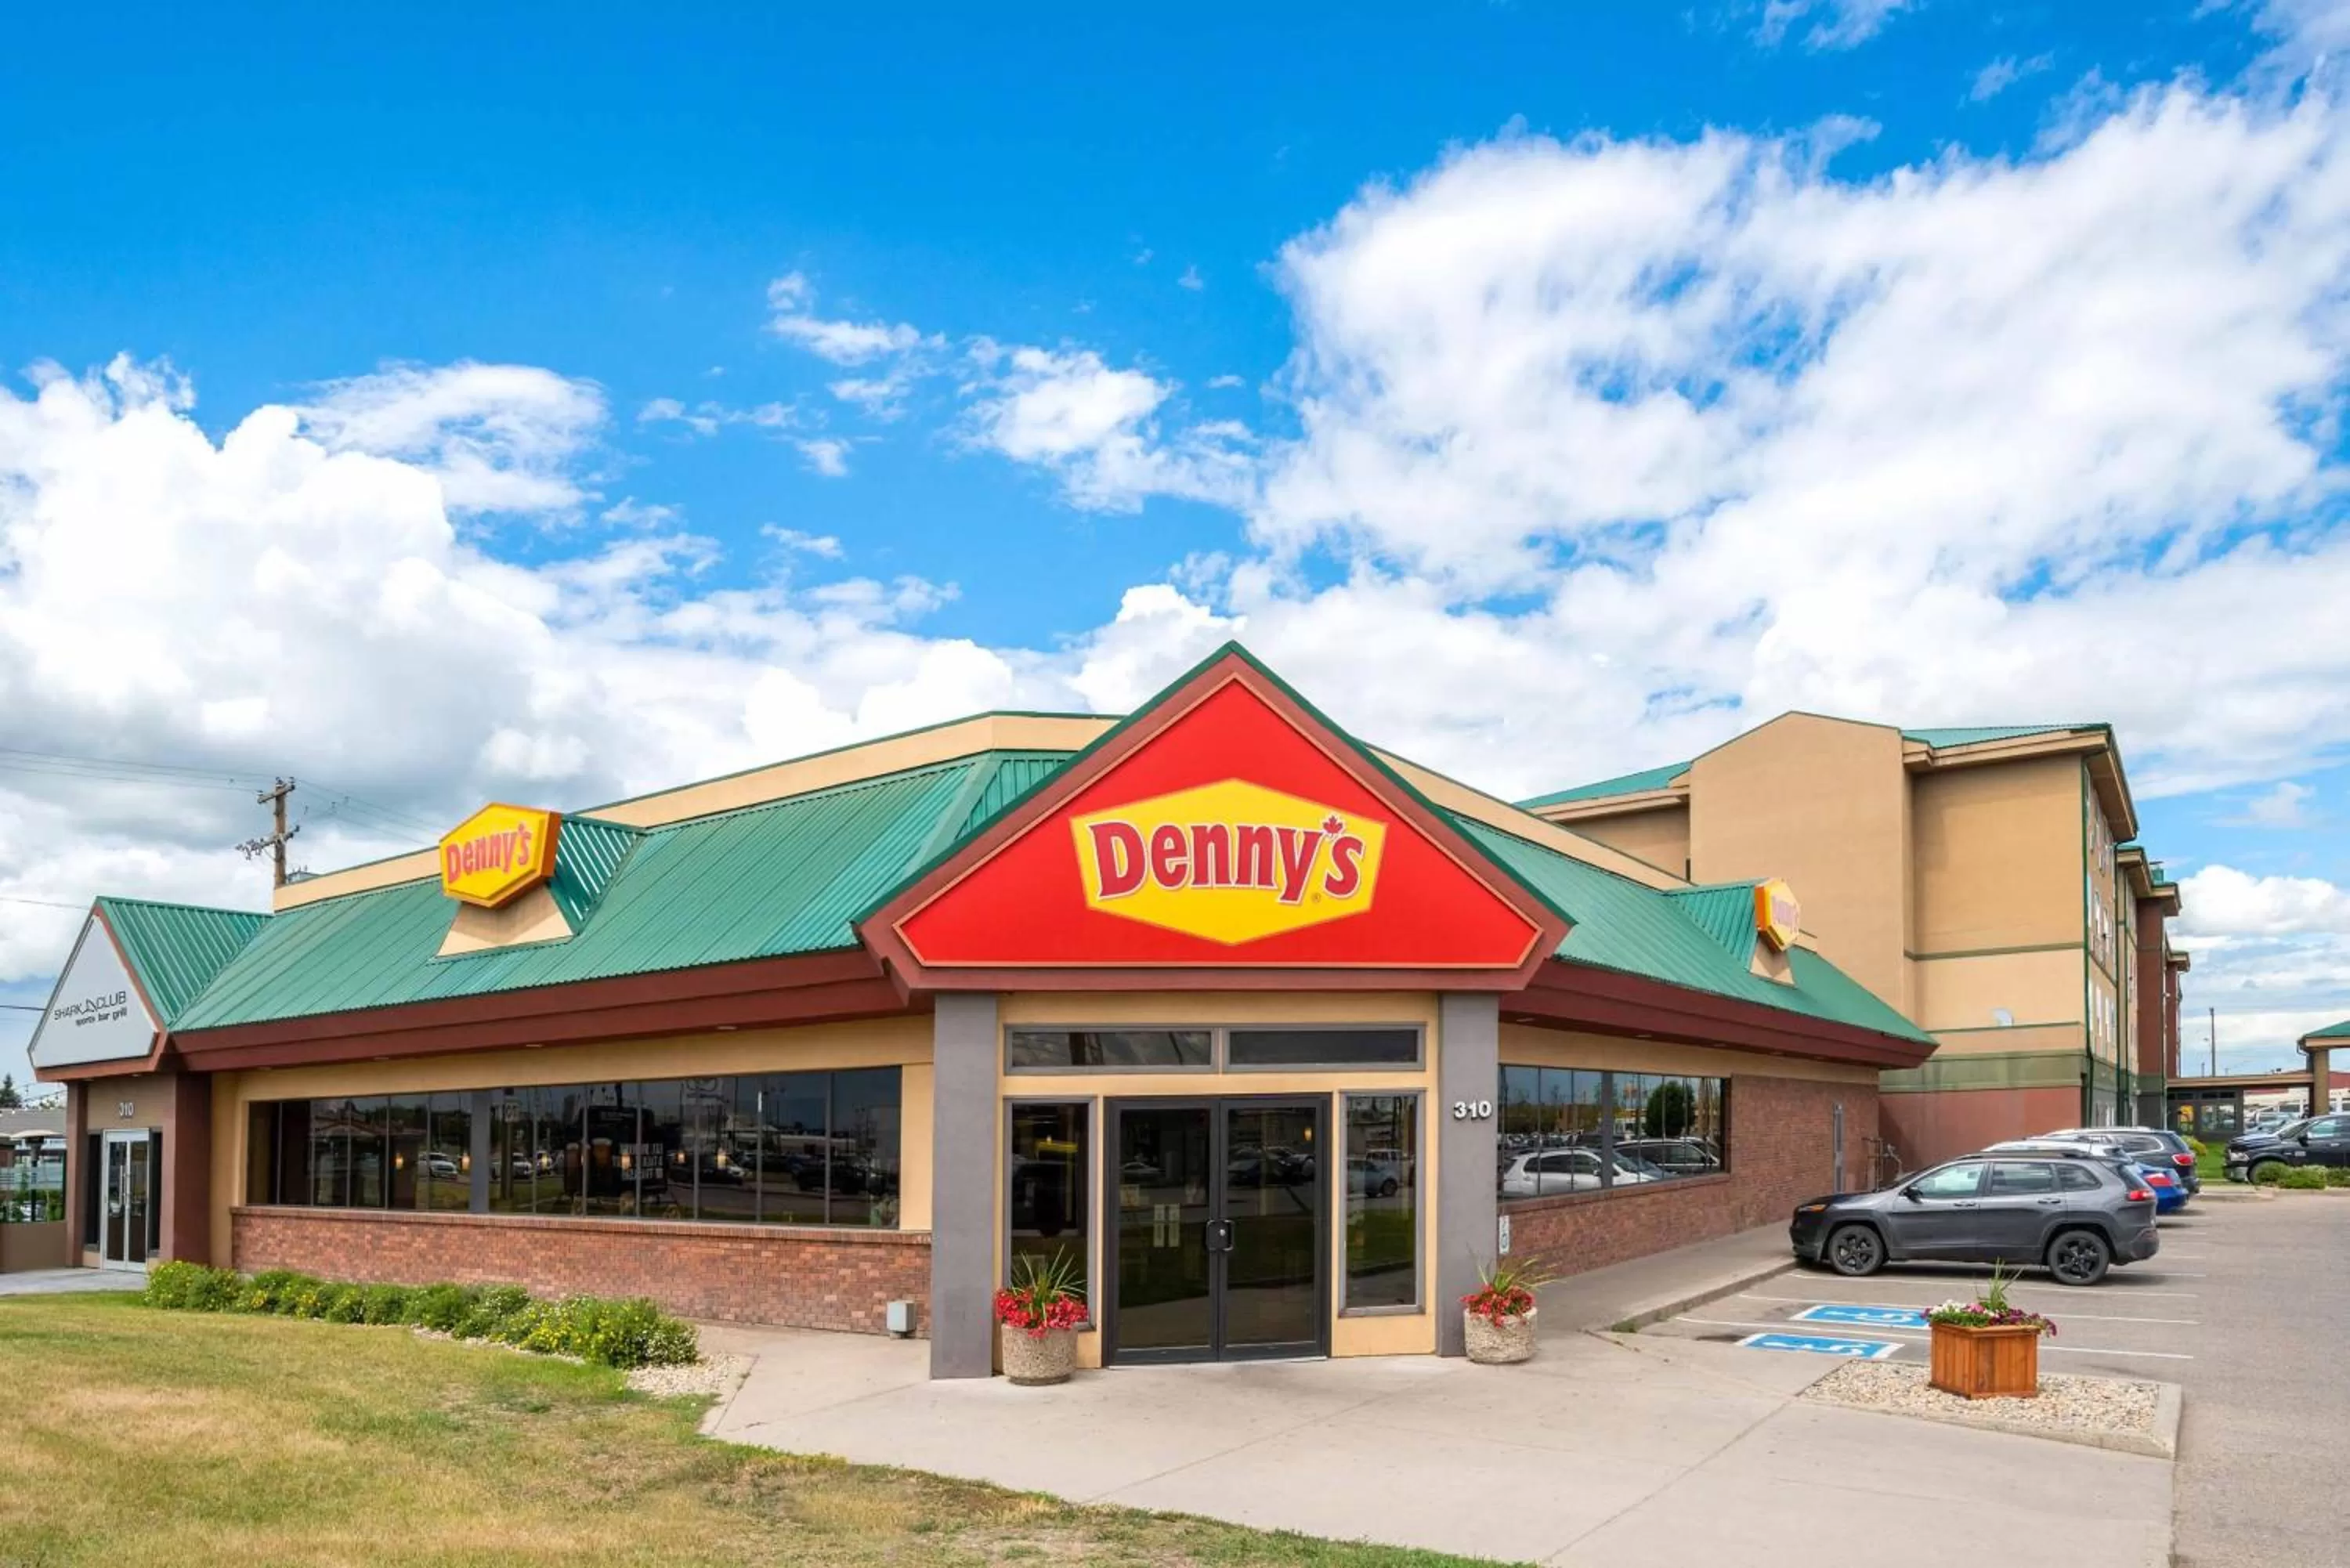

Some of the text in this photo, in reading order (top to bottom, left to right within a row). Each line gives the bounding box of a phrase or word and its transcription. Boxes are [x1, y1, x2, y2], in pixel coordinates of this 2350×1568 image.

[446, 823, 532, 883] Denny's
[1087, 815, 1365, 904] Denny's
[96, 991, 126, 1009] CLUB
[1453, 1100, 1492, 1118] 310
